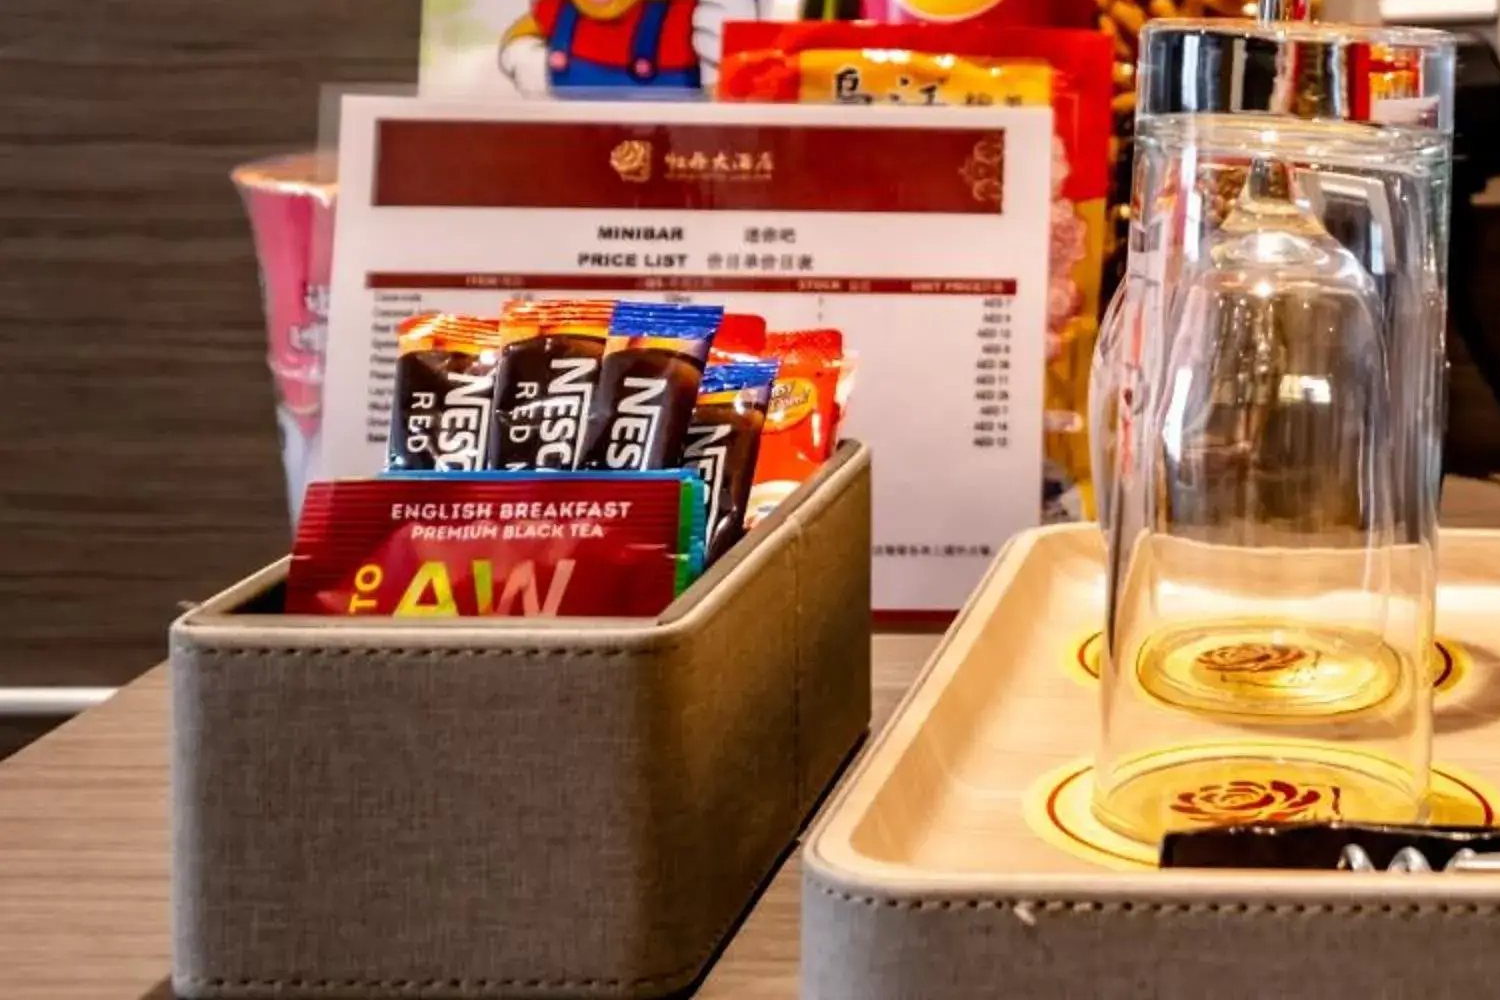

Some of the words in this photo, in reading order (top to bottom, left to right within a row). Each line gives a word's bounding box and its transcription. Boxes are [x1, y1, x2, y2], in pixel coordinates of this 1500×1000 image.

[597, 226, 684, 242] MINIBAR
[577, 252, 638, 268] PRICE
[643, 252, 689, 268] LIST
[508, 381, 539, 444] RED
[406, 391, 436, 453] RED
[391, 502, 492, 520] ENGLISH
[499, 501, 633, 519] BREAKFAST
[410, 524, 498, 540] PREMIUM
[502, 524, 565, 540] BLACK
[569, 524, 605, 539] TEA
